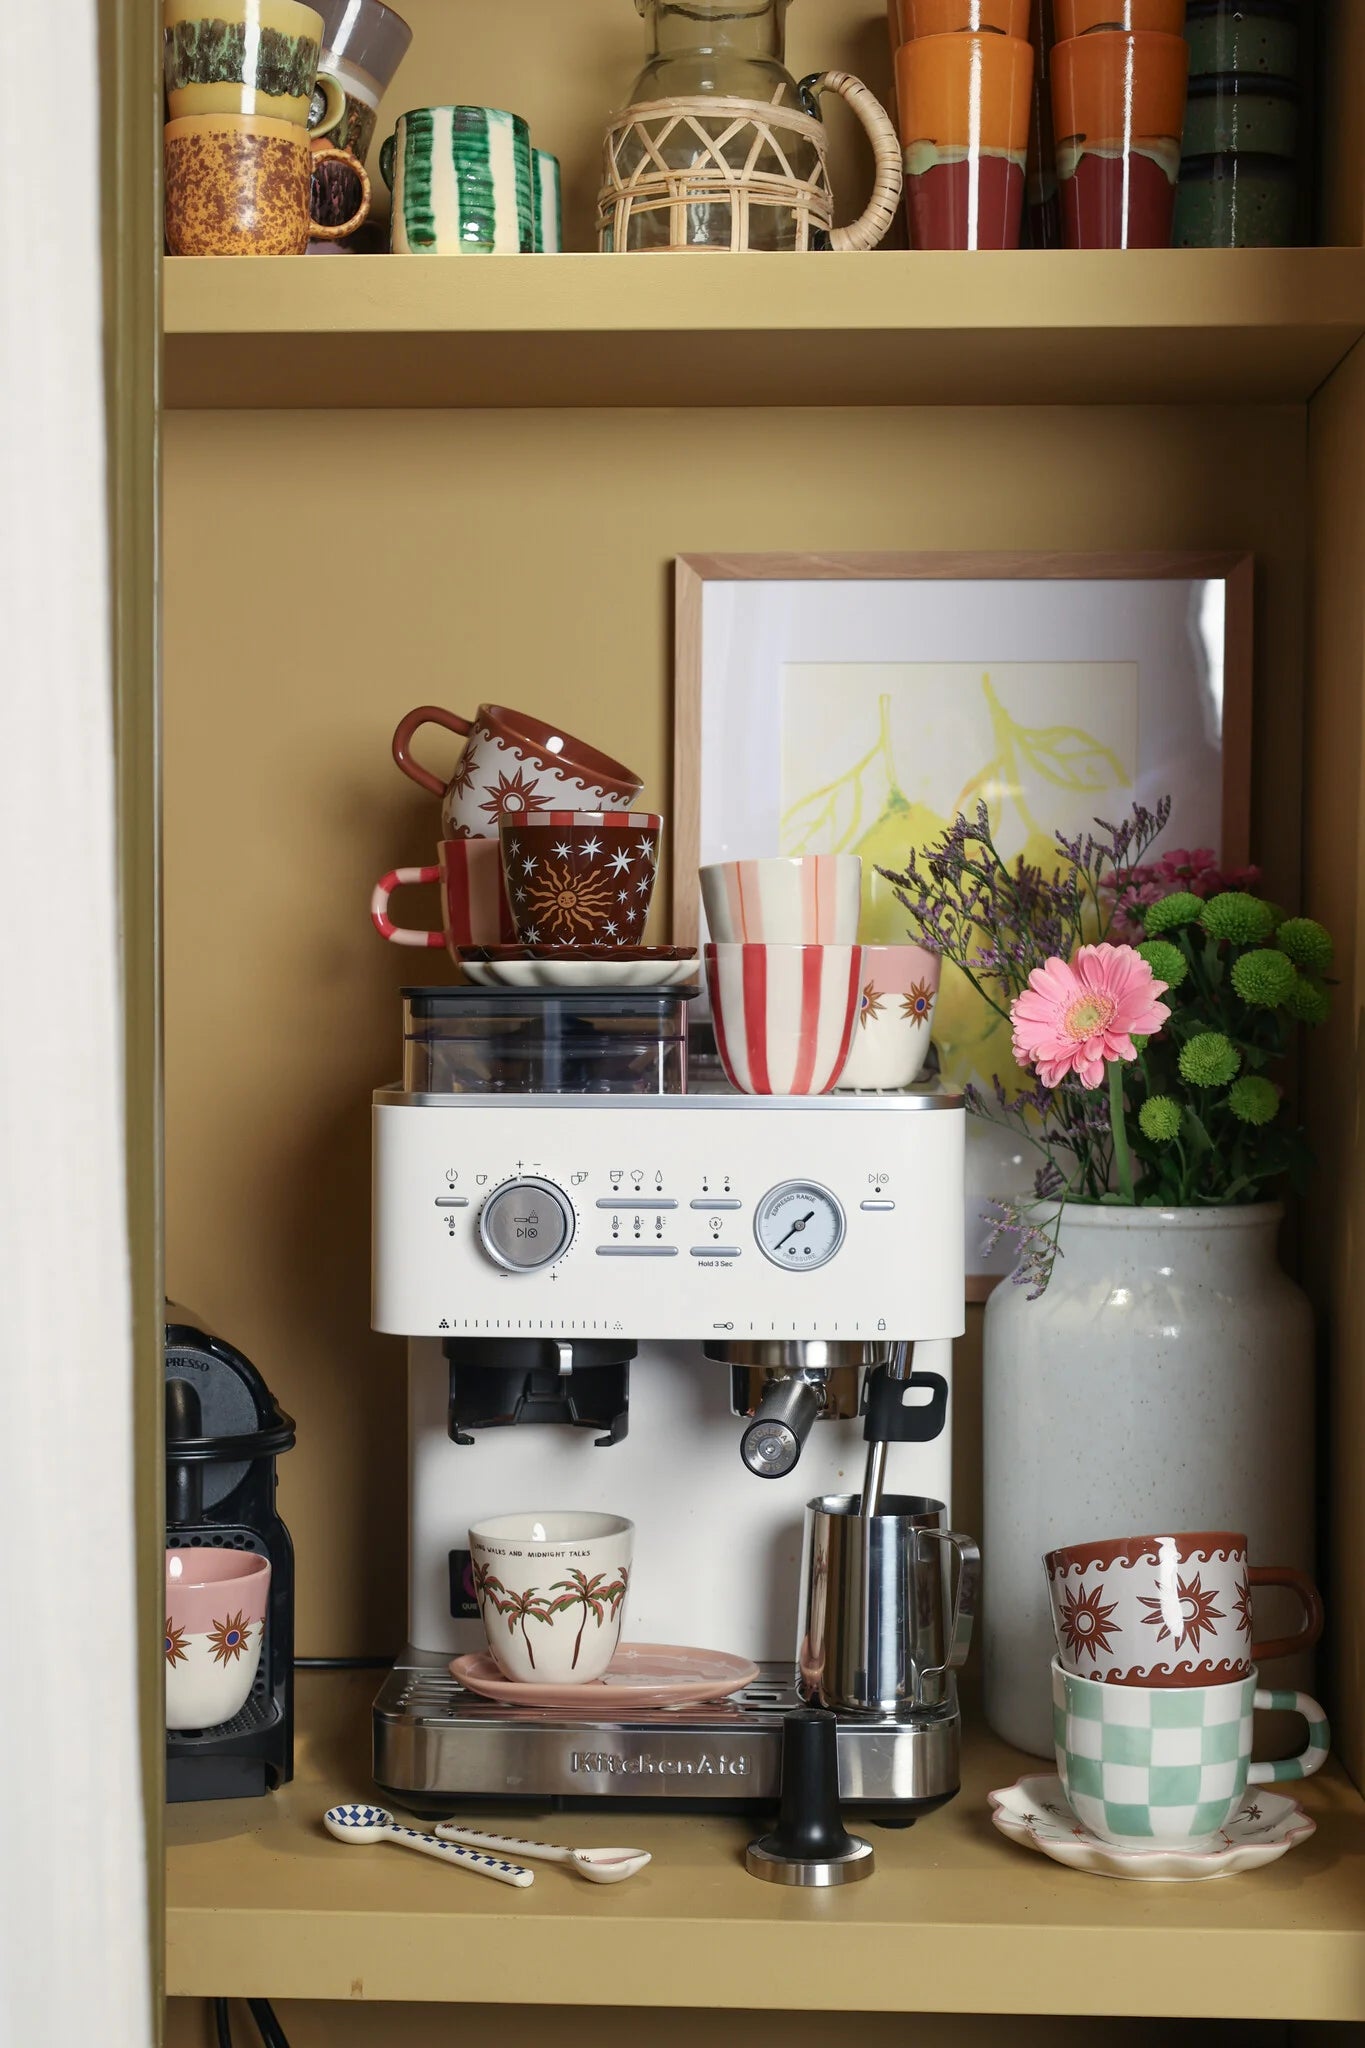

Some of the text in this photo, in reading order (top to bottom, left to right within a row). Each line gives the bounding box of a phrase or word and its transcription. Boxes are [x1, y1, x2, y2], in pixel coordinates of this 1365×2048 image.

[724, 1176, 730, 1184] 2
[771, 1193, 817, 1217] ESPRESSO RANGE
[166, 1357, 210, 1372] PRESSO
[487, 1546, 506, 1556] WALKS
[462, 1602, 477, 1610] QUIE
[571, 1751, 751, 1775] KitchenAid
